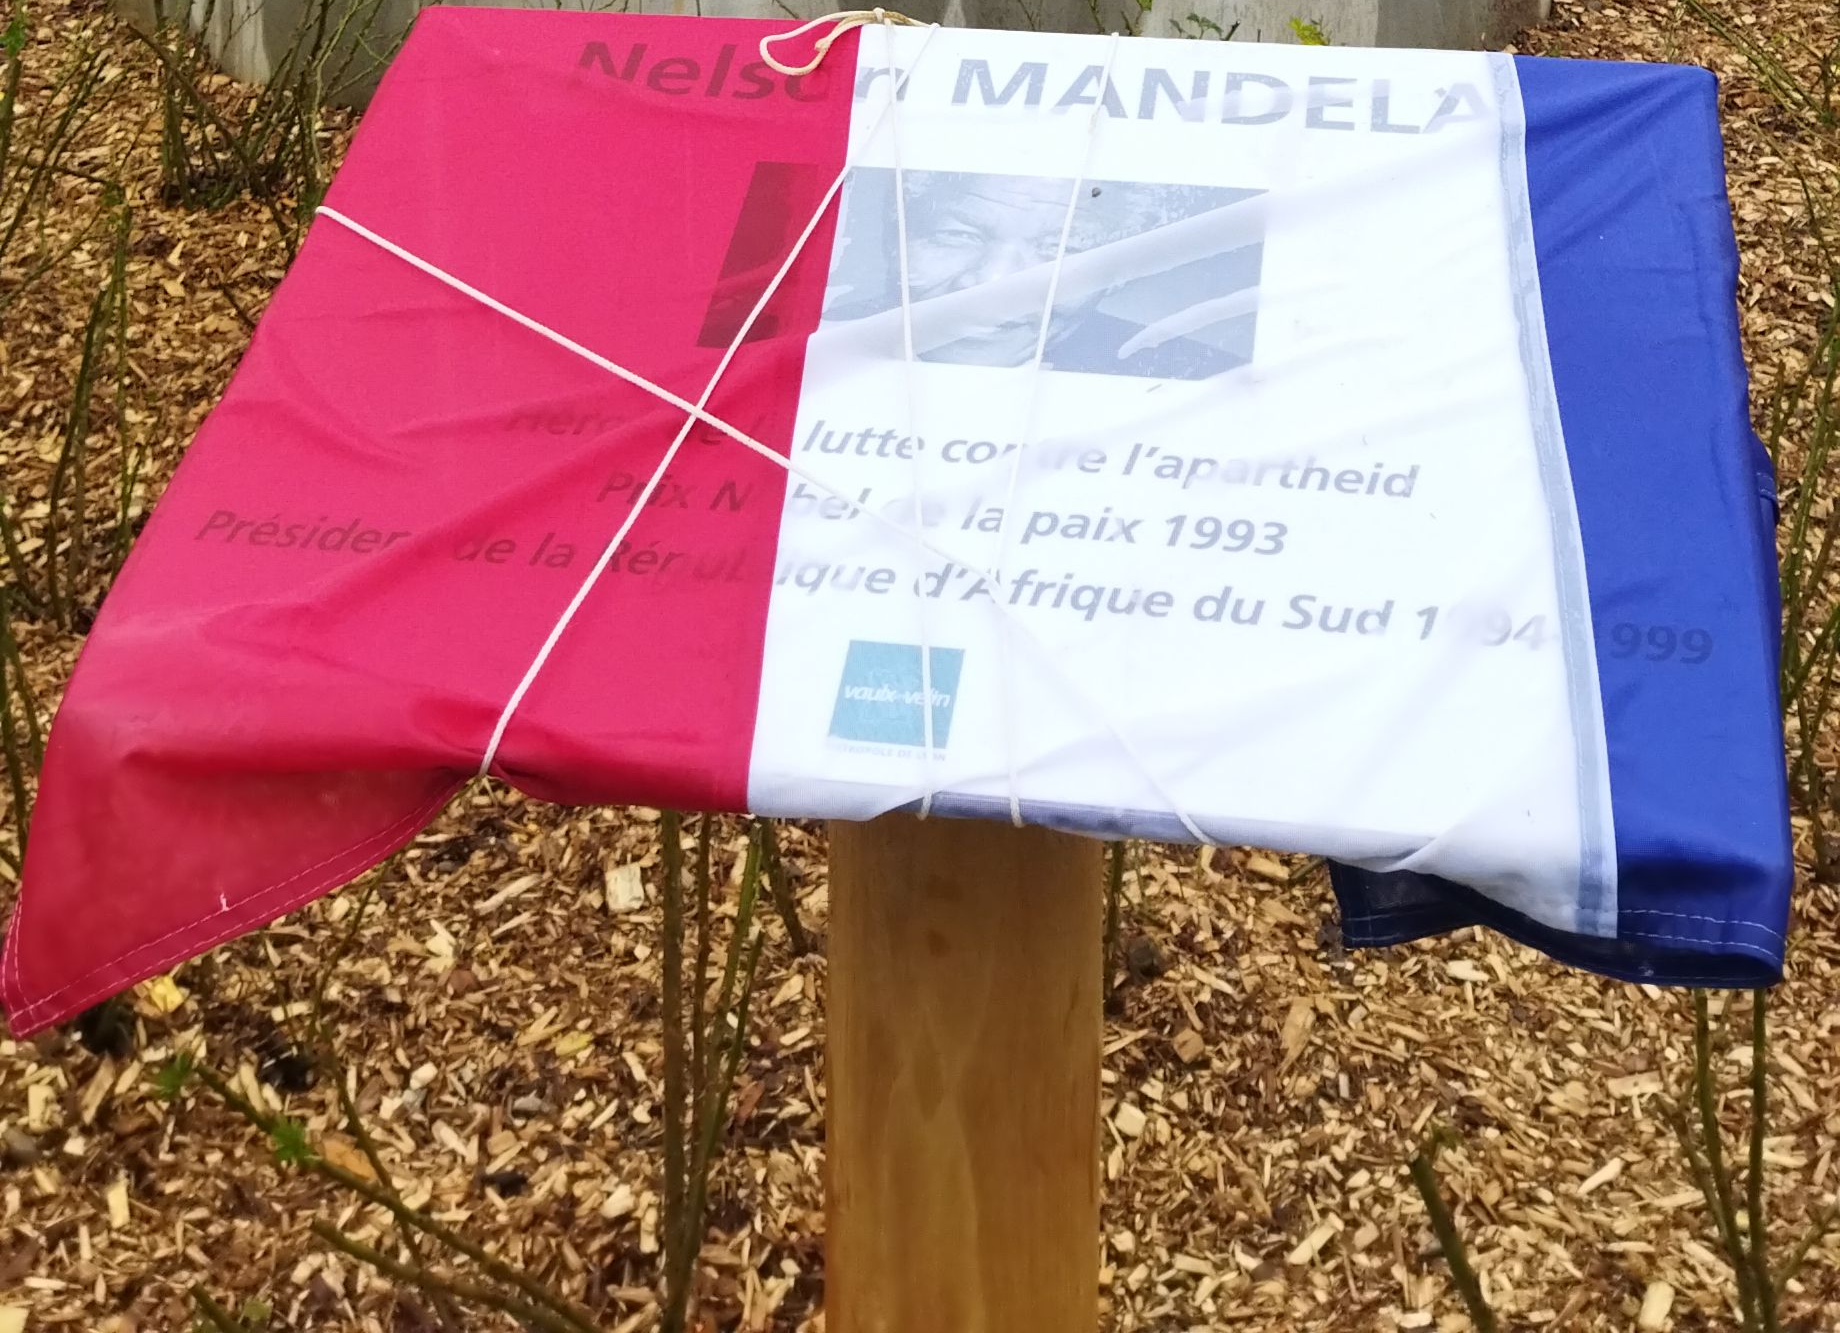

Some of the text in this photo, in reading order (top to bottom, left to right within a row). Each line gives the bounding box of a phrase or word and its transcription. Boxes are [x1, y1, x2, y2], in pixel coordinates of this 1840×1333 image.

[951, 58, 1494, 134] MANDELA
[801, 419, 925, 461] lutte
[709, 478, 873, 521] Nbel
[960, 494, 1005, 533] la
[1020, 507, 1144, 545] paix
[1165, 514, 1289, 557] 1993
[528, 532, 578, 570] la
[1193, 585, 1265, 627] du
[1282, 594, 1396, 637] Sud
